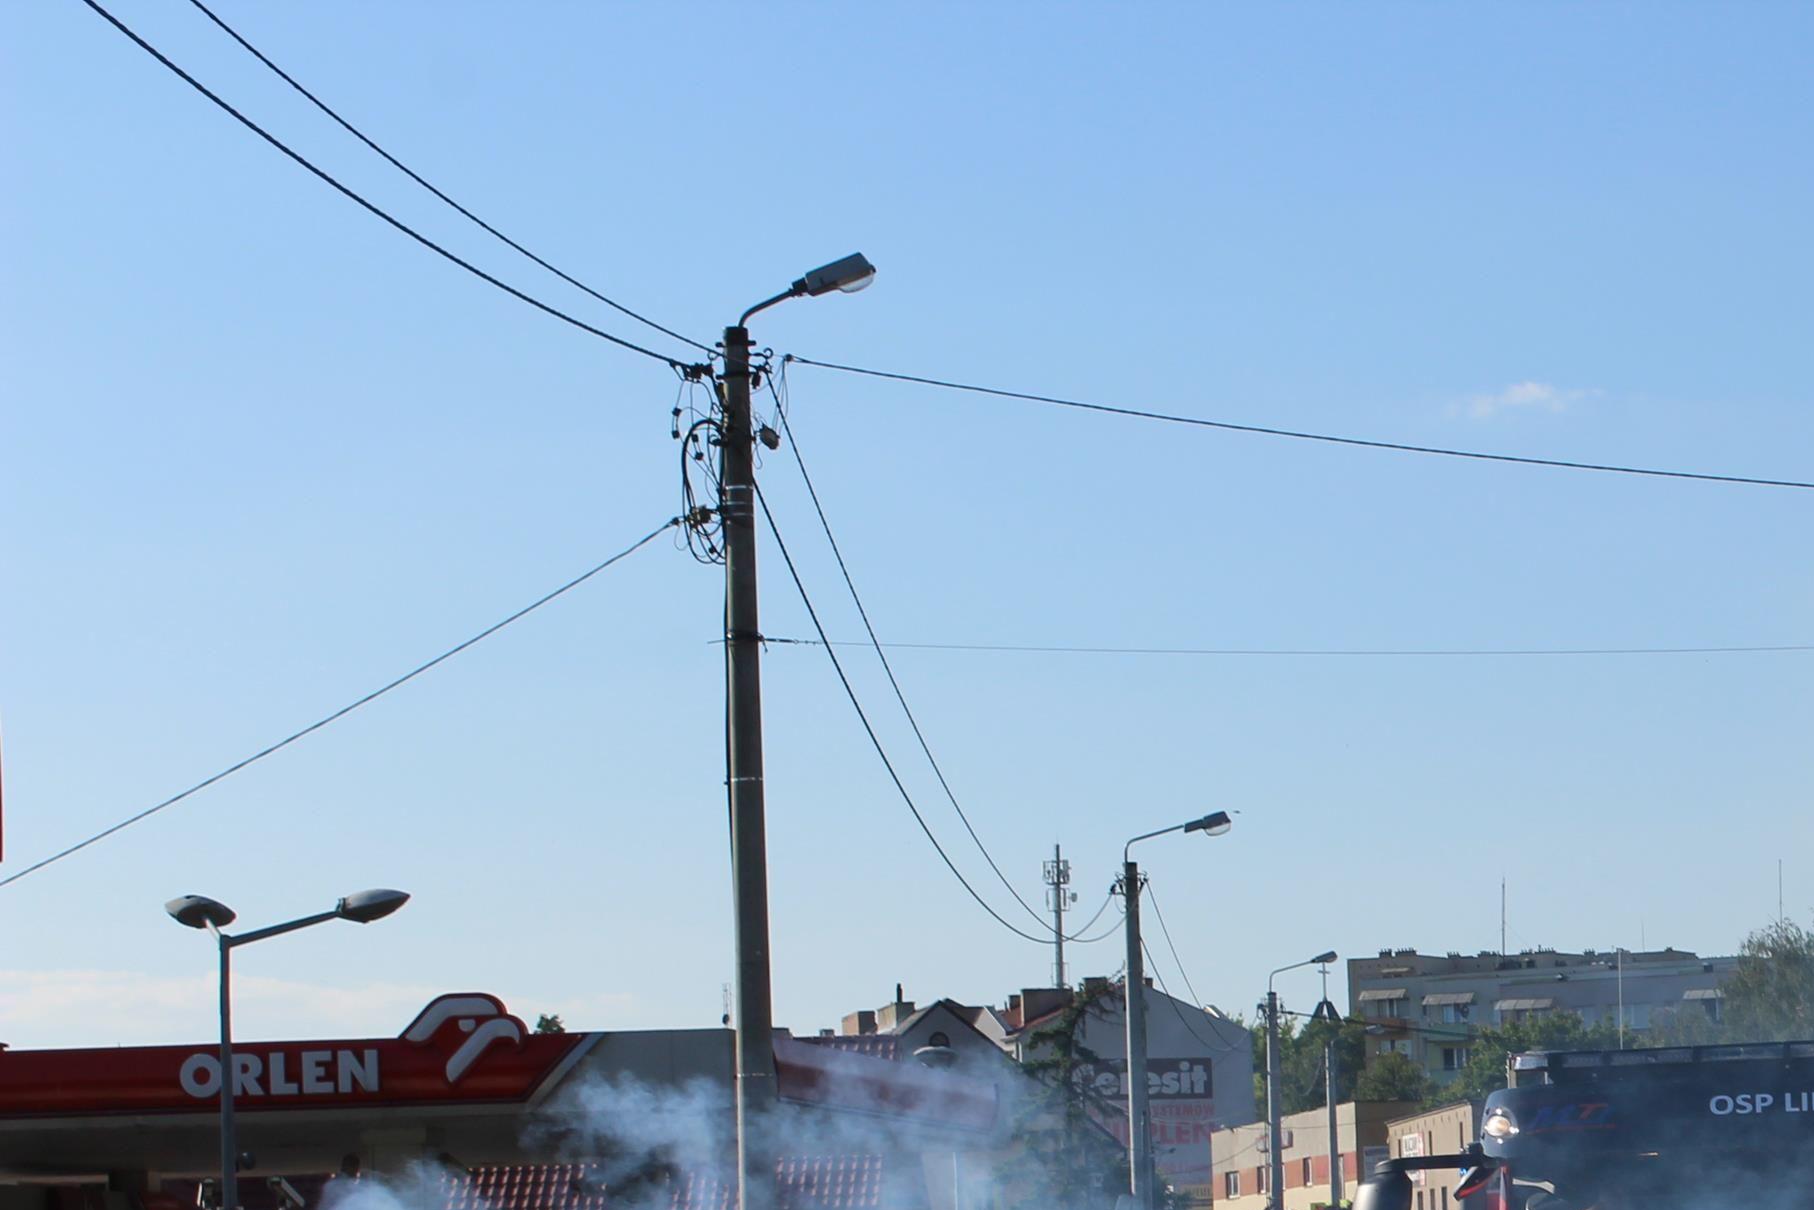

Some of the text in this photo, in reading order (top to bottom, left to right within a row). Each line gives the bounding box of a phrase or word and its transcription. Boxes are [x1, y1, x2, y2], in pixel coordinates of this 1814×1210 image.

[179, 1049, 379, 1099] ORLEN
[1072, 1061, 1208, 1095] Ceesit
[1710, 1094, 1774, 1115] OSP
